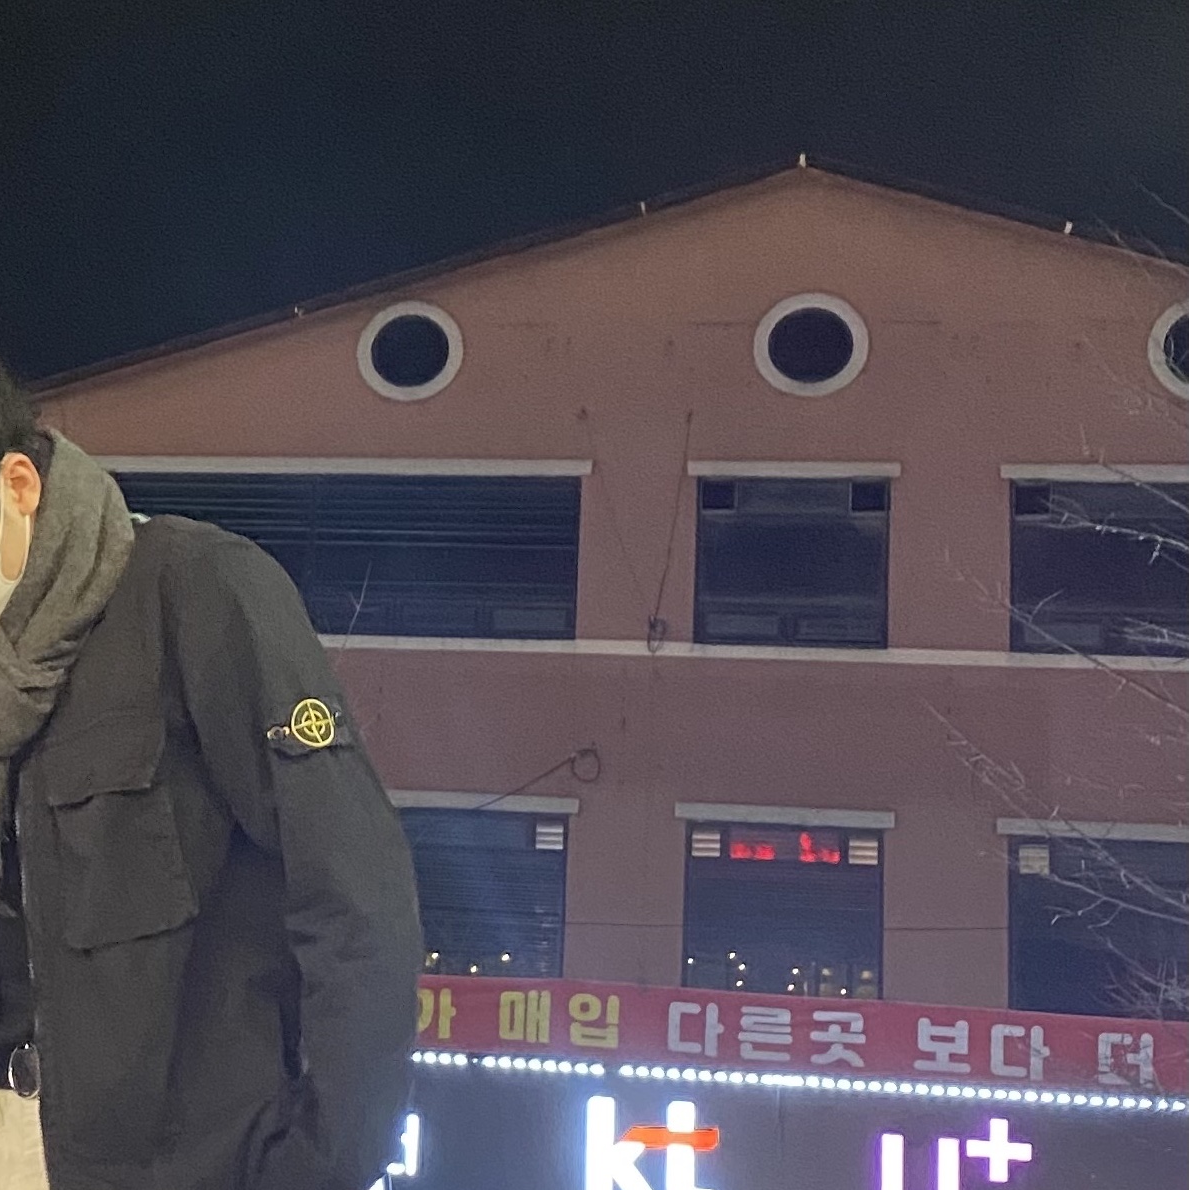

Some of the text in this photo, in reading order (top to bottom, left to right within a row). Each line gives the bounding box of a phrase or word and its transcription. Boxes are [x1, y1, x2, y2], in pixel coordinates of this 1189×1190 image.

[498, 989, 621, 1050] 매입
[667, 1000, 867, 1068] 다른곳
[913, 1016, 1051, 1082] 보다
[1097, 1031, 1155, 1090] 더
